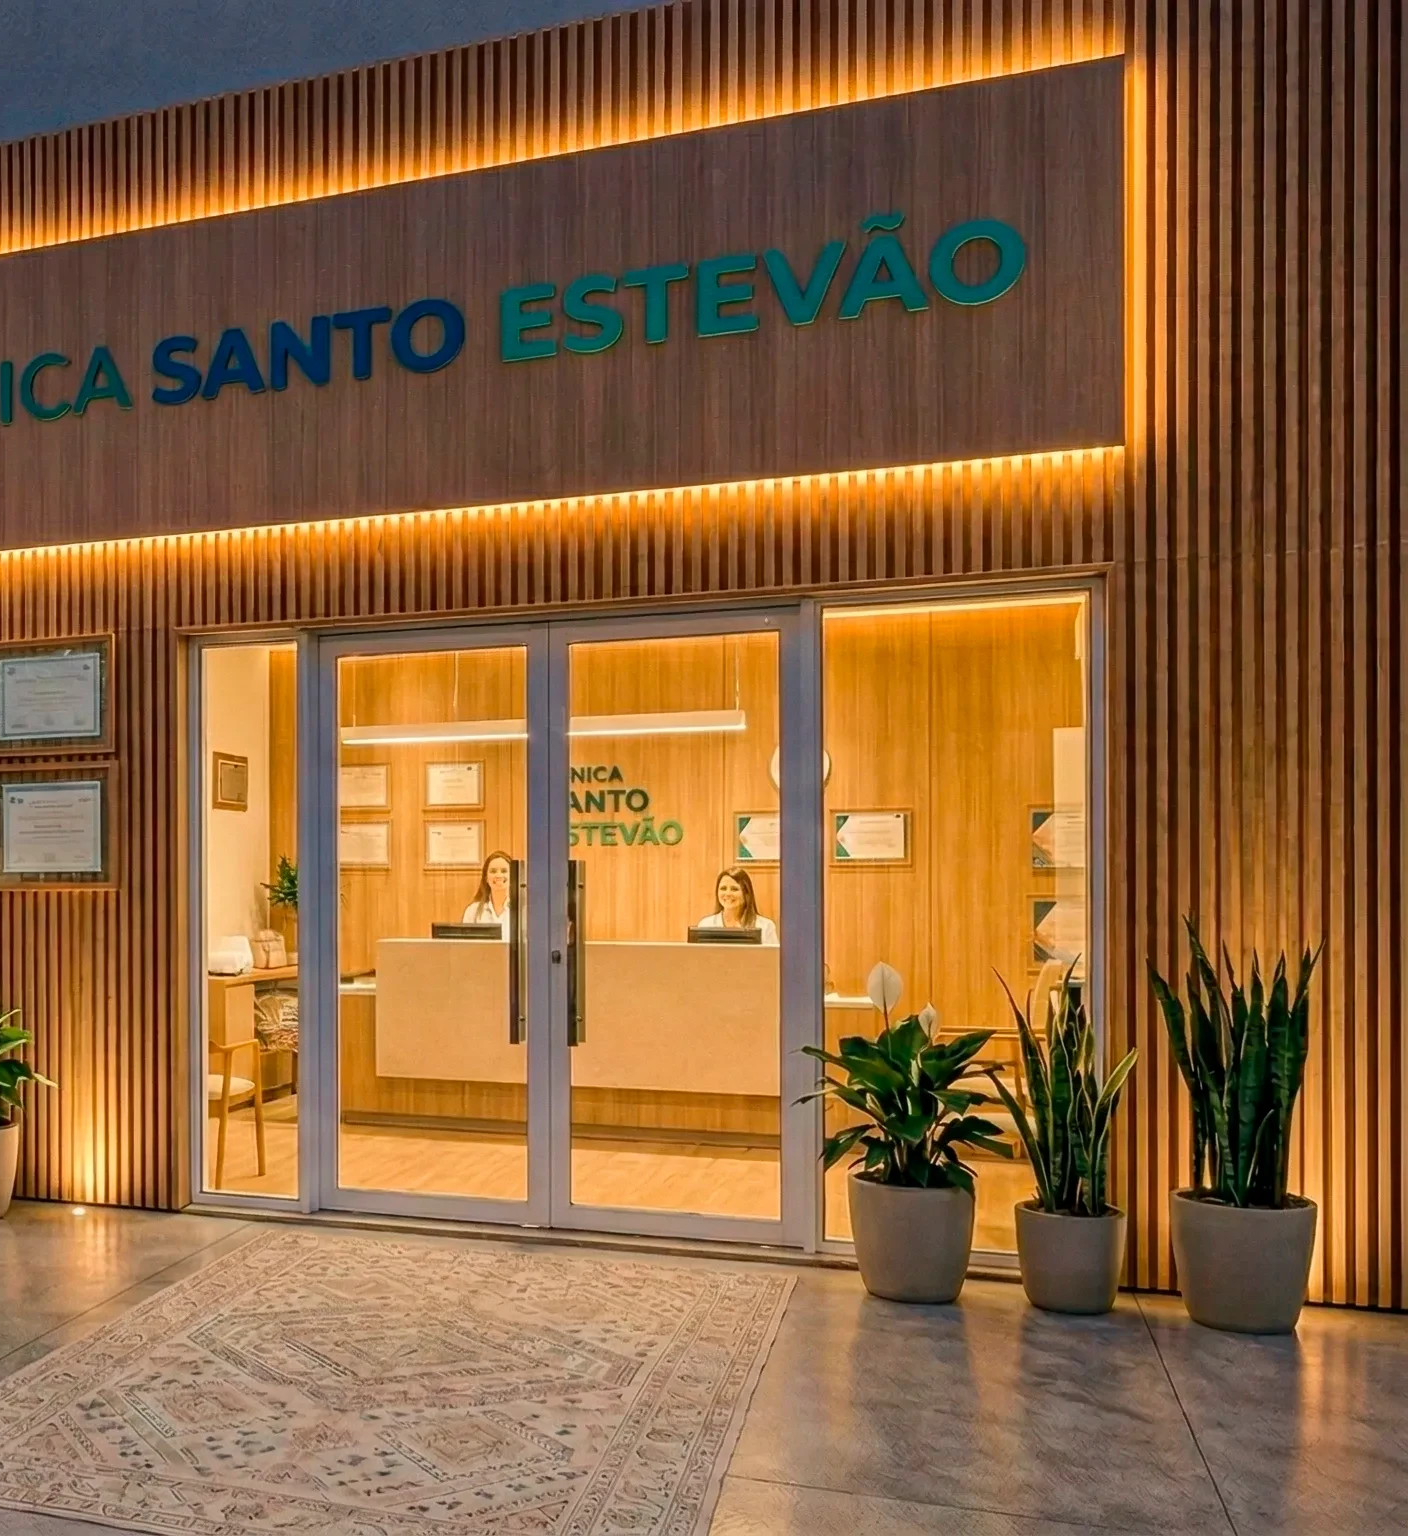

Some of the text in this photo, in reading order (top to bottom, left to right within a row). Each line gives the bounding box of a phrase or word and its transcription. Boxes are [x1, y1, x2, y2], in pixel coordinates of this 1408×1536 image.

[152, 298, 466, 406] SANTO
[500, 210, 1026, 362] ESTEVÃO
[570, 765, 624, 784] NICA
[569, 788, 650, 814] ANTO
[569, 816, 684, 847] STEVÃO
